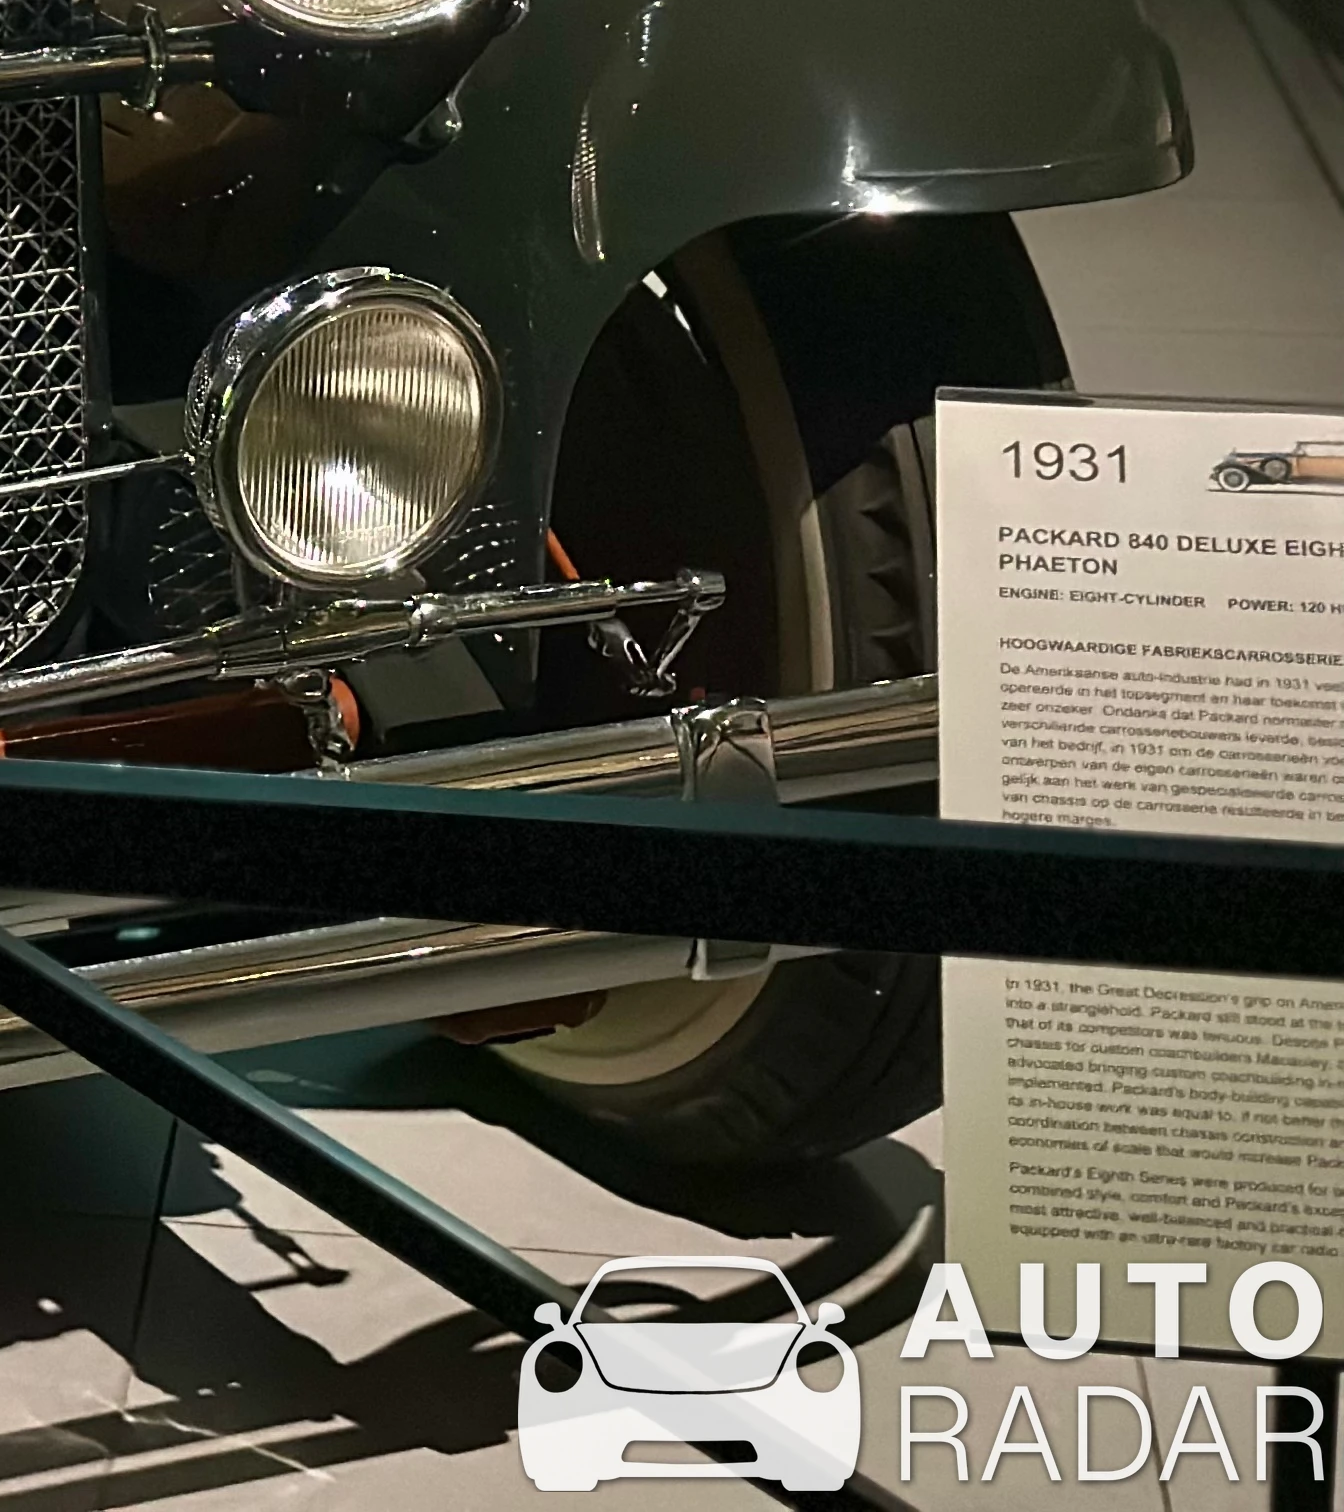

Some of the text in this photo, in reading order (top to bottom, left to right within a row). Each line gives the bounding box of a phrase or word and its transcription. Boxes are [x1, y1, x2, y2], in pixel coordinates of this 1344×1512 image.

[1002, 440, 1127, 483] 1931
[998, 526, 1120, 549] PACKARD
[1128, 533, 1169, 551] 840
[1176, 535, 1277, 556] DELUXE
[999, 553, 1118, 575] PHAETON
[999, 586, 1344, 615] ENGINE: EIGHT-CYLINDER POWER: 120 H
[999, 637, 1137, 656] HOOGWAARDIGE
[1000, 662, 1020, 675] De
[1025, 664, 1118, 680] Amerikaanse
[1225, 675, 1252, 688] had
[1257, 677, 1269, 688] in
[1276, 676, 1309, 690] 1931
[1000, 682, 1073, 696] opereerde
[1078, 686, 1090, 697] in
[1094, 686, 1117, 698] het
[1122, 688, 1205, 704] topsegment
[1210, 694, 1228, 704] en
[1233, 693, 1266, 706] haar
[1001, 701, 1031, 711] zeer
[1103, 704, 1167, 720] Ondanks
[1171, 709, 1193, 721] dat
[1199, 709, 1258, 725] Packard
[1001, 738, 1027, 749] van
[1031, 737, 1054, 749] het
[1110, 743, 1125, 755] in
[1130, 743, 1164, 756] 1931
[1169, 747, 1192, 757] om
[1196, 746, 1214, 758] de
[1082, 759, 1108, 771] van
[1112, 761, 1131, 772] de
[1134, 762, 1174, 777] eigen
[1043, 776, 1070, 787] aan
[1074, 776, 1097, 788] het
[1102, 780, 1136, 791] werk
[1141, 782, 1168, 793] van
[1002, 791, 1028, 803] van
[1091, 798, 1110, 809] op
[1113, 797, 1132, 809] de
[1309, 809, 1322, 820] in
[1069, 982, 1094, 994] the
[1098, 983, 1140, 997] Great
[1276, 998, 1295, 1008] on
[1151, 1006, 1211, 1022] Packard
[1290, 1017, 1305, 1028] at
[1038, 1019, 1052, 1031] of
[1168, 1030, 1198, 1040] was
[1065, 1041, 1086, 1052] for
[1137, 1105, 1168, 1117] was
[1009, 1161, 1082, 1179] Packard's
[1191, 1196, 1221, 1208] and
